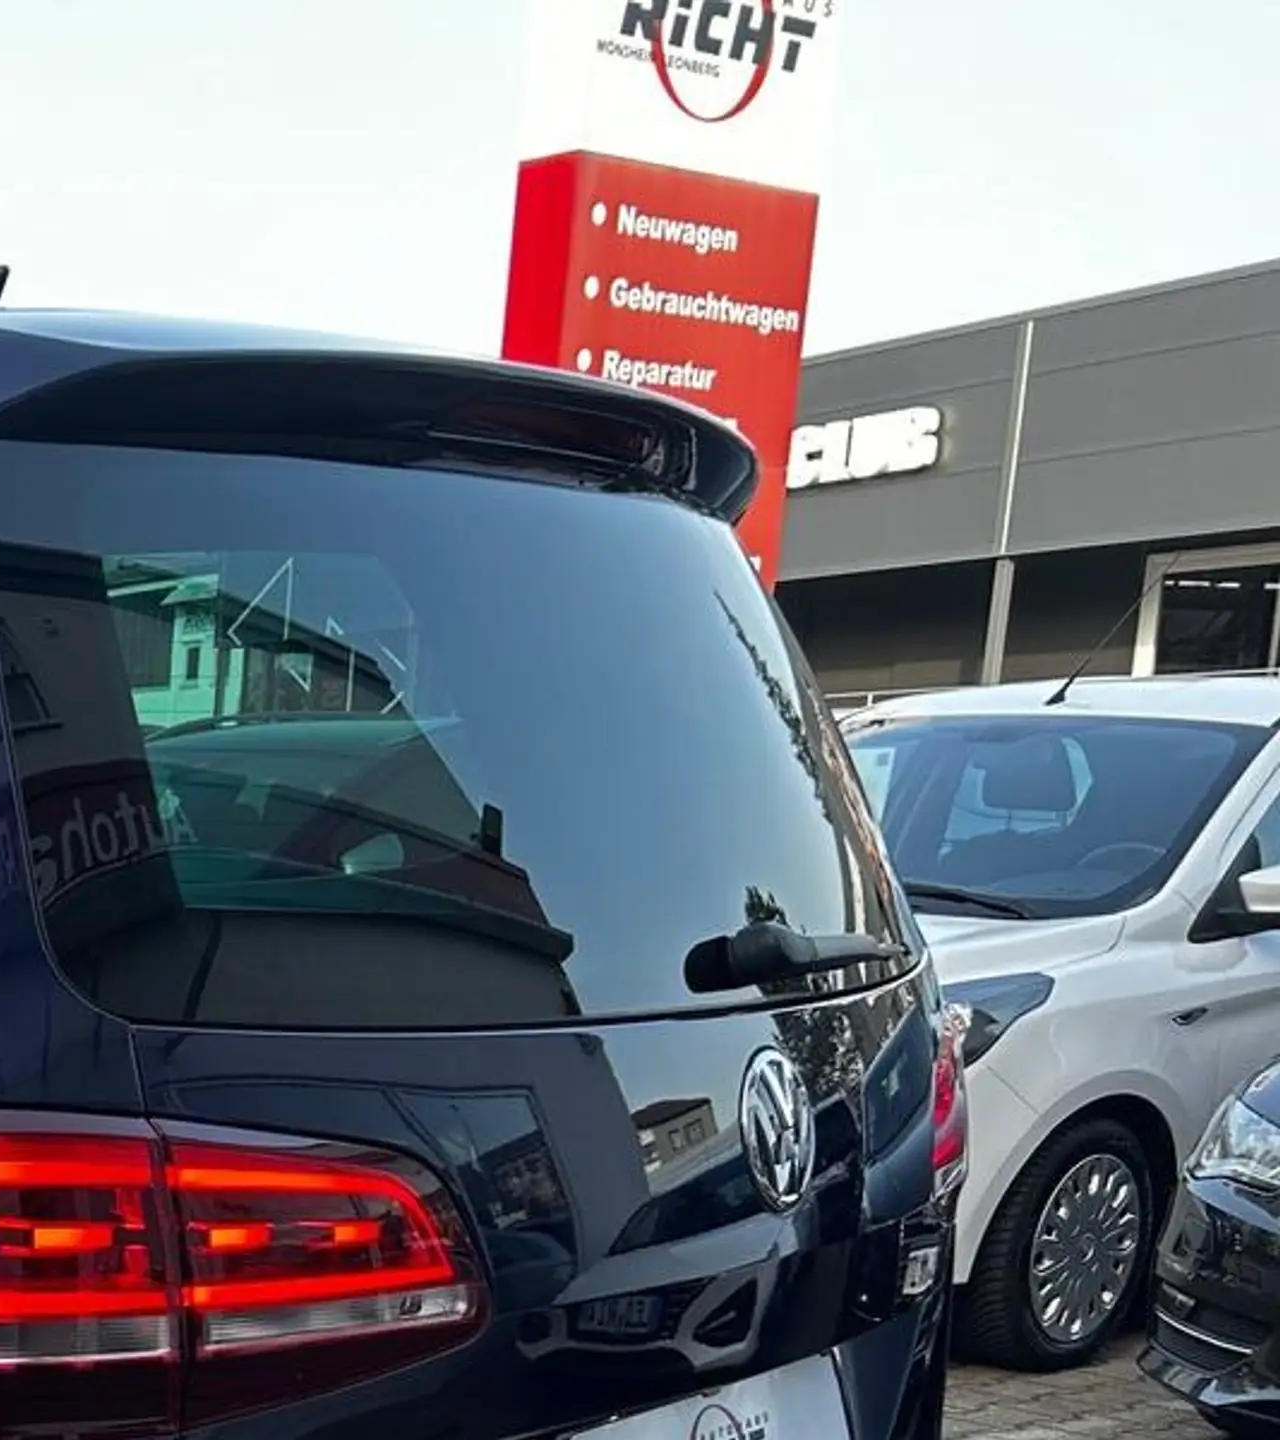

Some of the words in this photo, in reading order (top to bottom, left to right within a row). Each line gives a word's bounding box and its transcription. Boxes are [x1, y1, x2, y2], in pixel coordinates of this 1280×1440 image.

[666, 53, 721, 79] EONBERG
[616, 203, 739, 254] Neuwagen
[609, 276, 800, 336] Gebrauchtwagen
[601, 349, 718, 391] Reparatur
